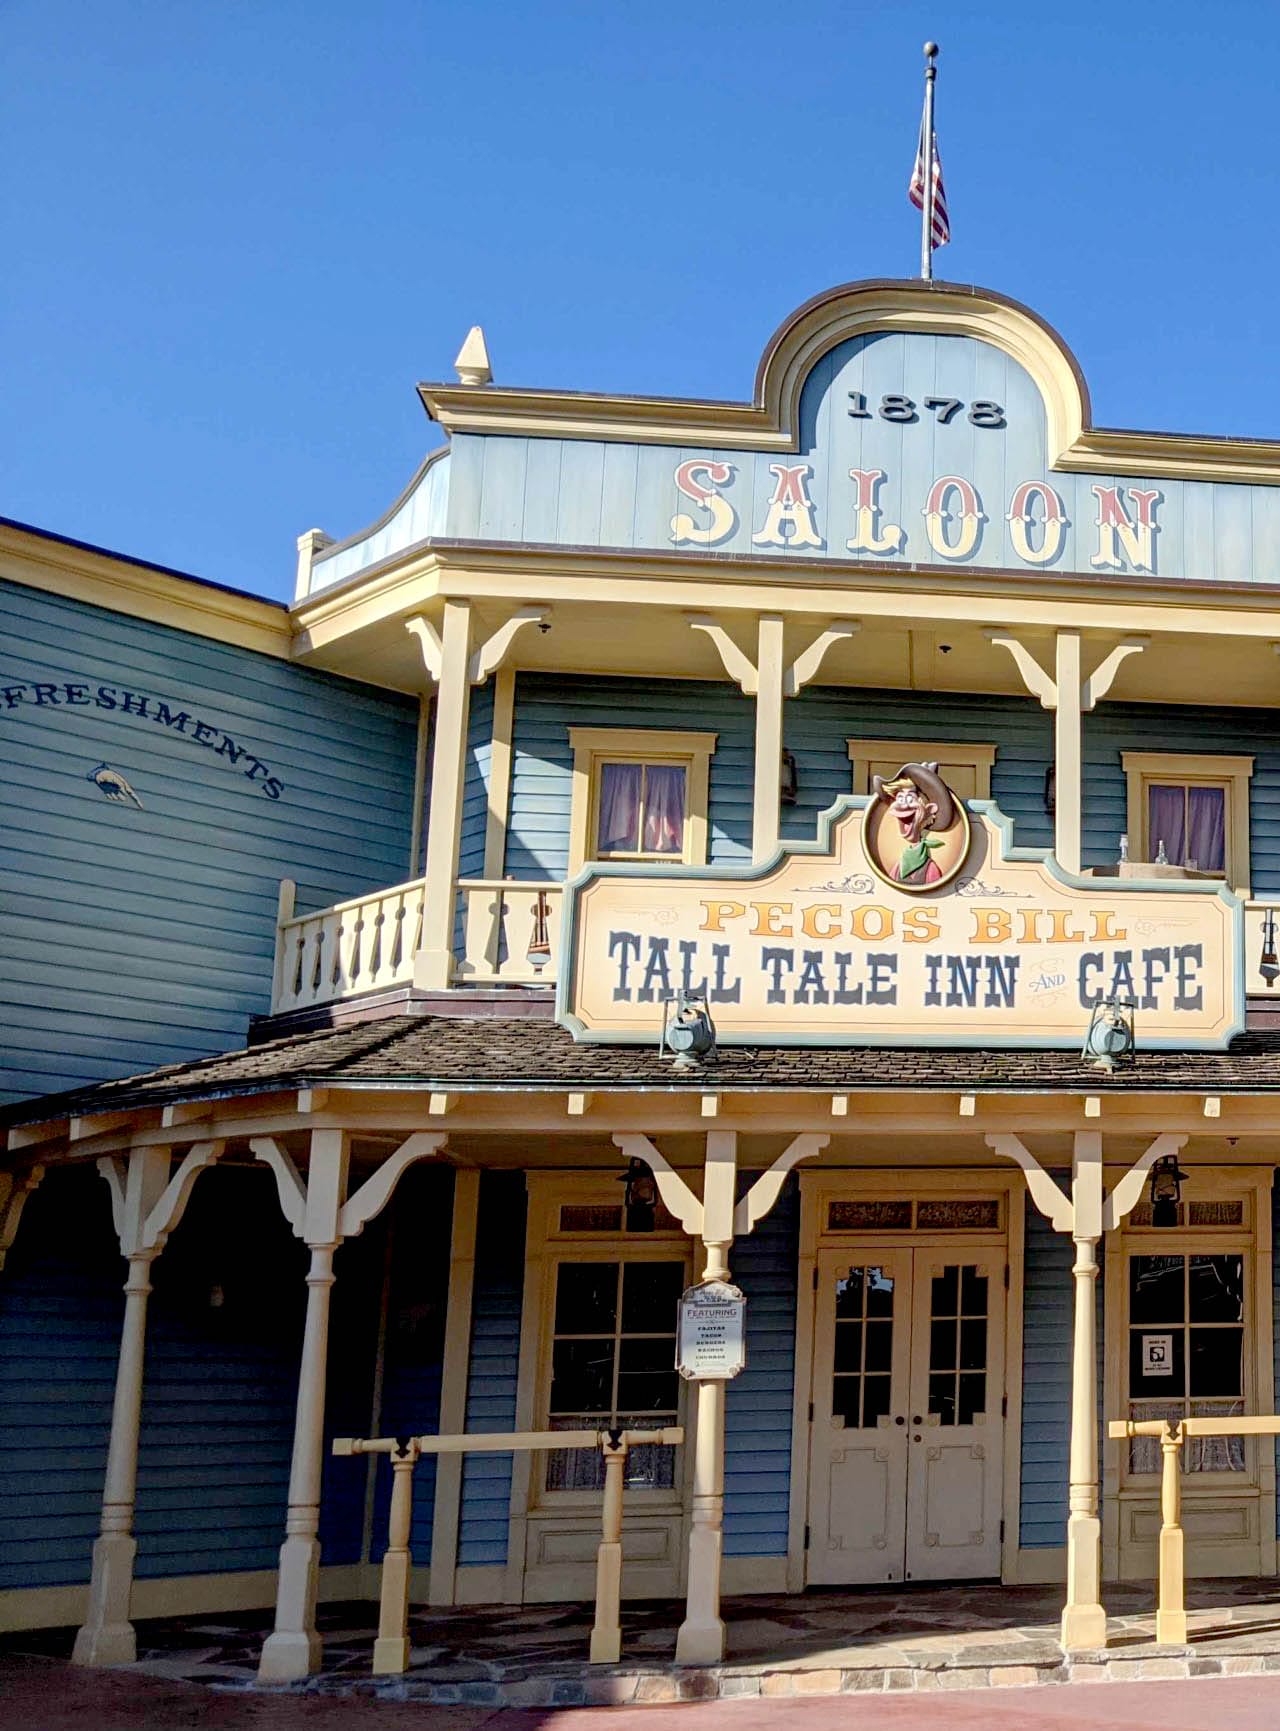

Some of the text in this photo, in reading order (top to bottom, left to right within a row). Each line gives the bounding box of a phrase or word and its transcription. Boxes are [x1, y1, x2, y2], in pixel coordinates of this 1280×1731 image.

[846, 390, 1007, 428] 1878
[667, 458, 1164, 573] SALOON
[698, 900, 1128, 943] PECOS BILL
[608, 930, 1203, 1012] TALL TALE INN AND CAFE
[688, 1309, 737, 1317] FEATURING
